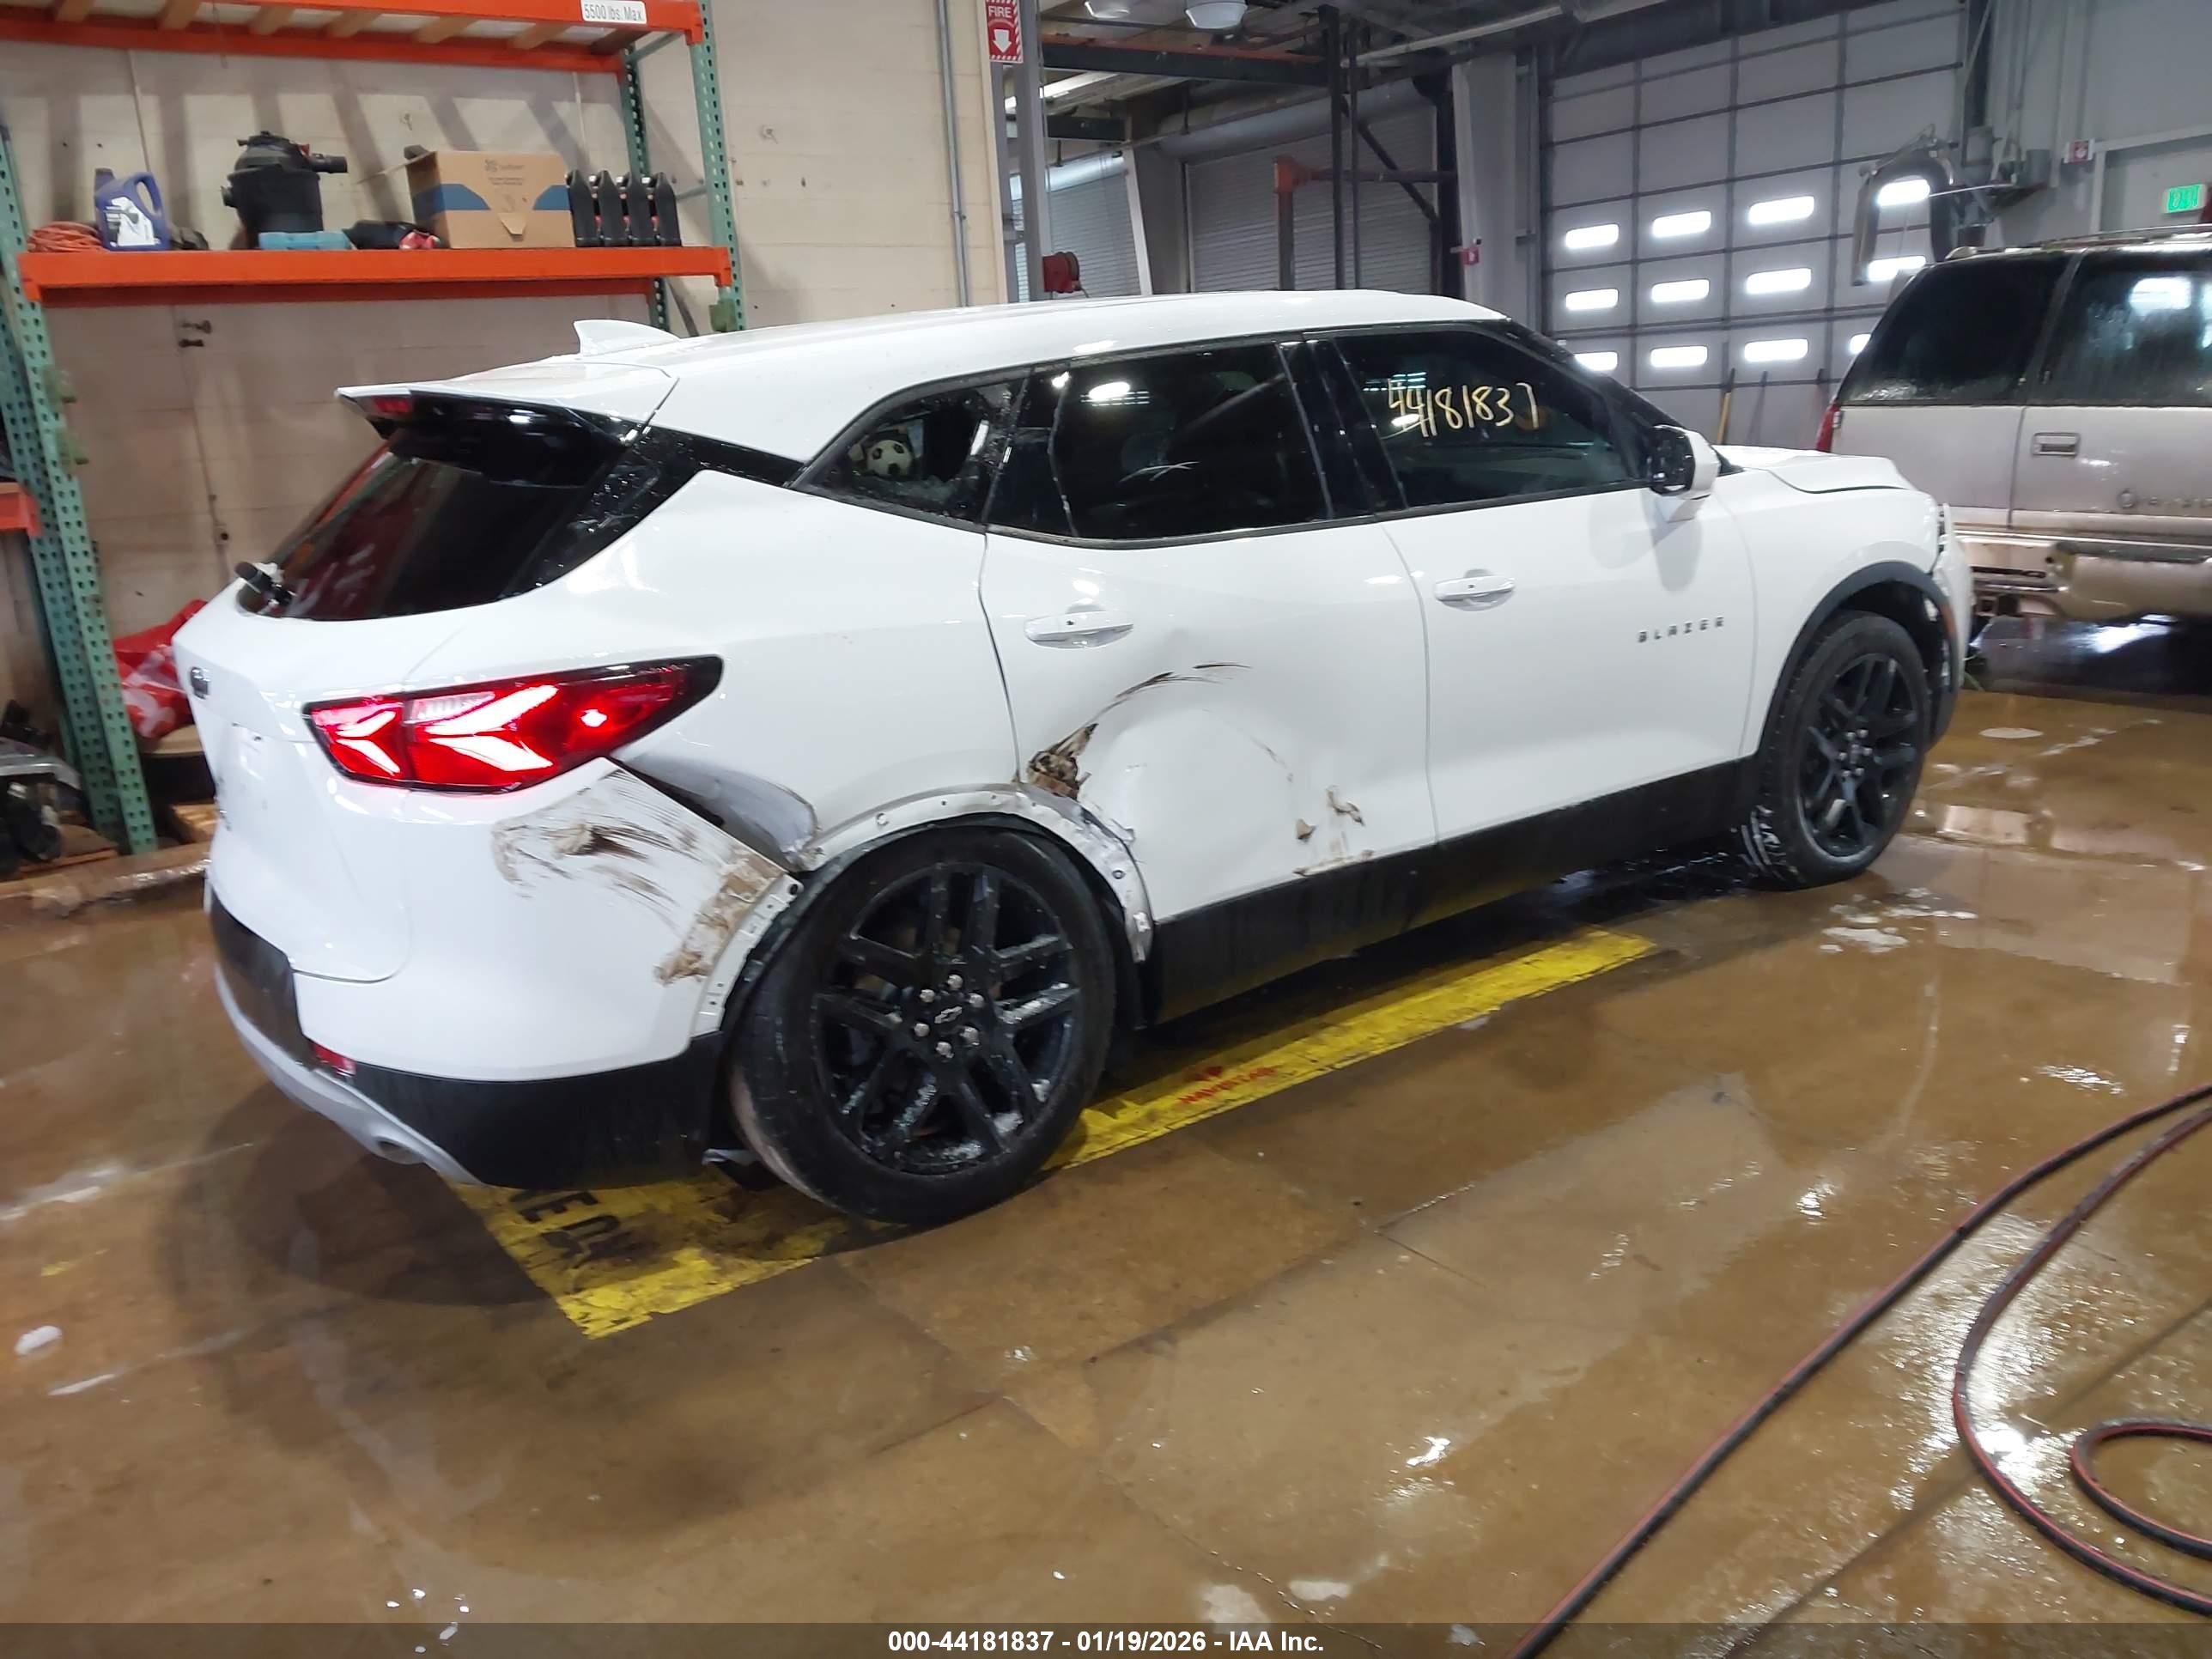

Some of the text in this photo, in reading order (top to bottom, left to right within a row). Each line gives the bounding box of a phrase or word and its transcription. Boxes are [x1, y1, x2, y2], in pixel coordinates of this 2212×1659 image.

[584, 3, 607, 19] 5500
[623, 6, 643, 21] Max
[988, 5, 1012, 18] FIRE
[1388, 379, 1539, 437] 44181837
[1638, 617, 1725, 643] BLAZER
